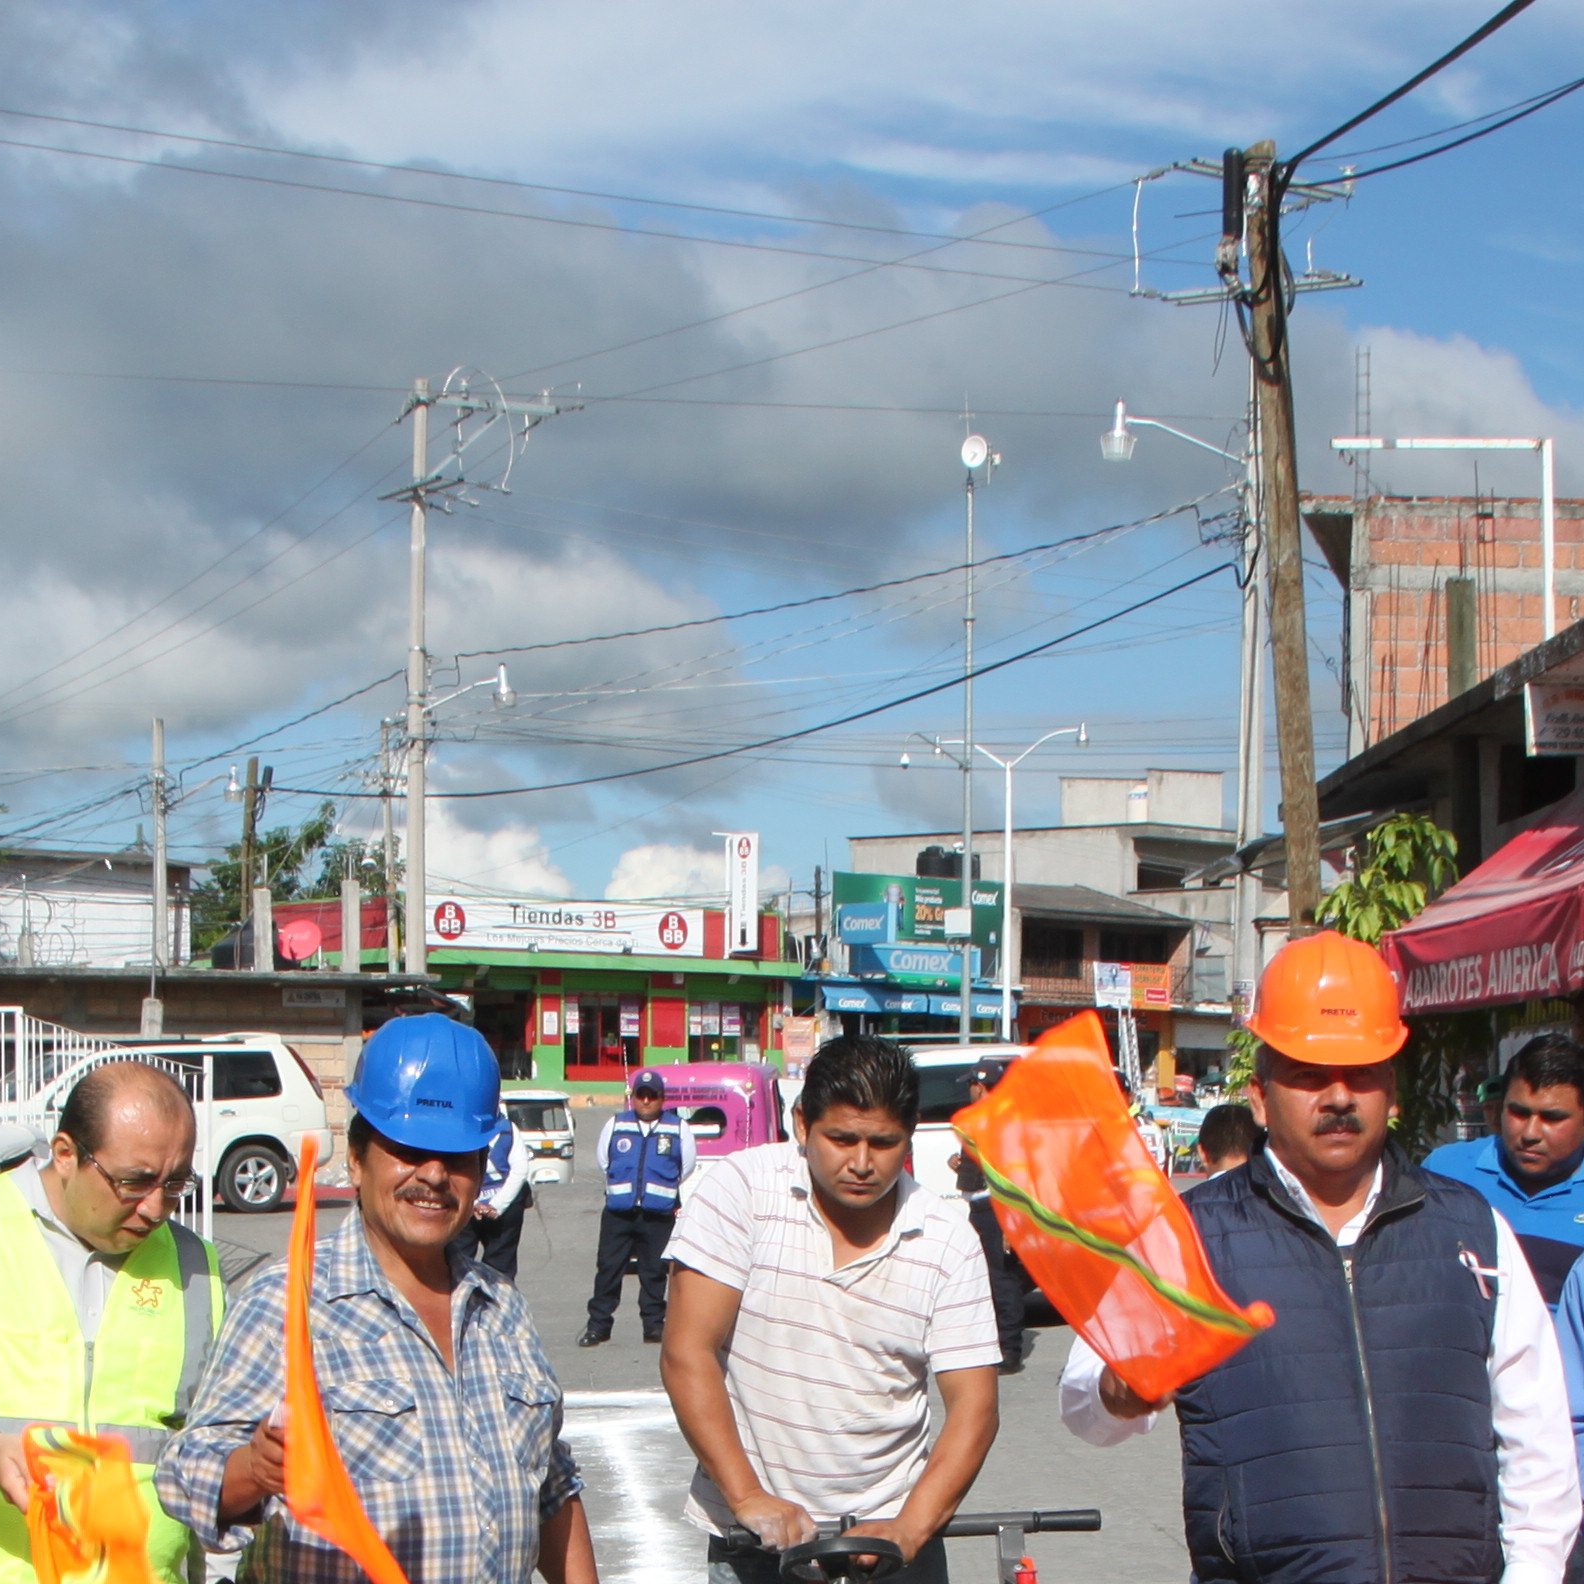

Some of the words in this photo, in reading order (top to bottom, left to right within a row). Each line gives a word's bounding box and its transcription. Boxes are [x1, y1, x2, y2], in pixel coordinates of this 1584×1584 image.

[972, 890, 998, 906] Comex
[509, 903, 584, 926] Tiendas
[592, 911, 616, 929] 3B
[915, 905, 933, 921] 20%
[843, 915, 884, 931] Comex
[487, 933, 504, 942] Los
[506, 934, 545, 946] Mejores
[548, 935, 583, 946] Precios
[586, 936, 613, 946] Cerca
[889, 950, 955, 972] Comex
[1403, 953, 1483, 1009] ABARROTES
[1485, 943, 1561, 996] AMERICA
[839, 998, 867, 1008] Comex
[884, 999, 914, 1010] Comex
[941, 1001, 962, 1012] Come
[1321, 1007, 1358, 1016] PRETUL
[416, 1098, 454, 1108] PRETUL
